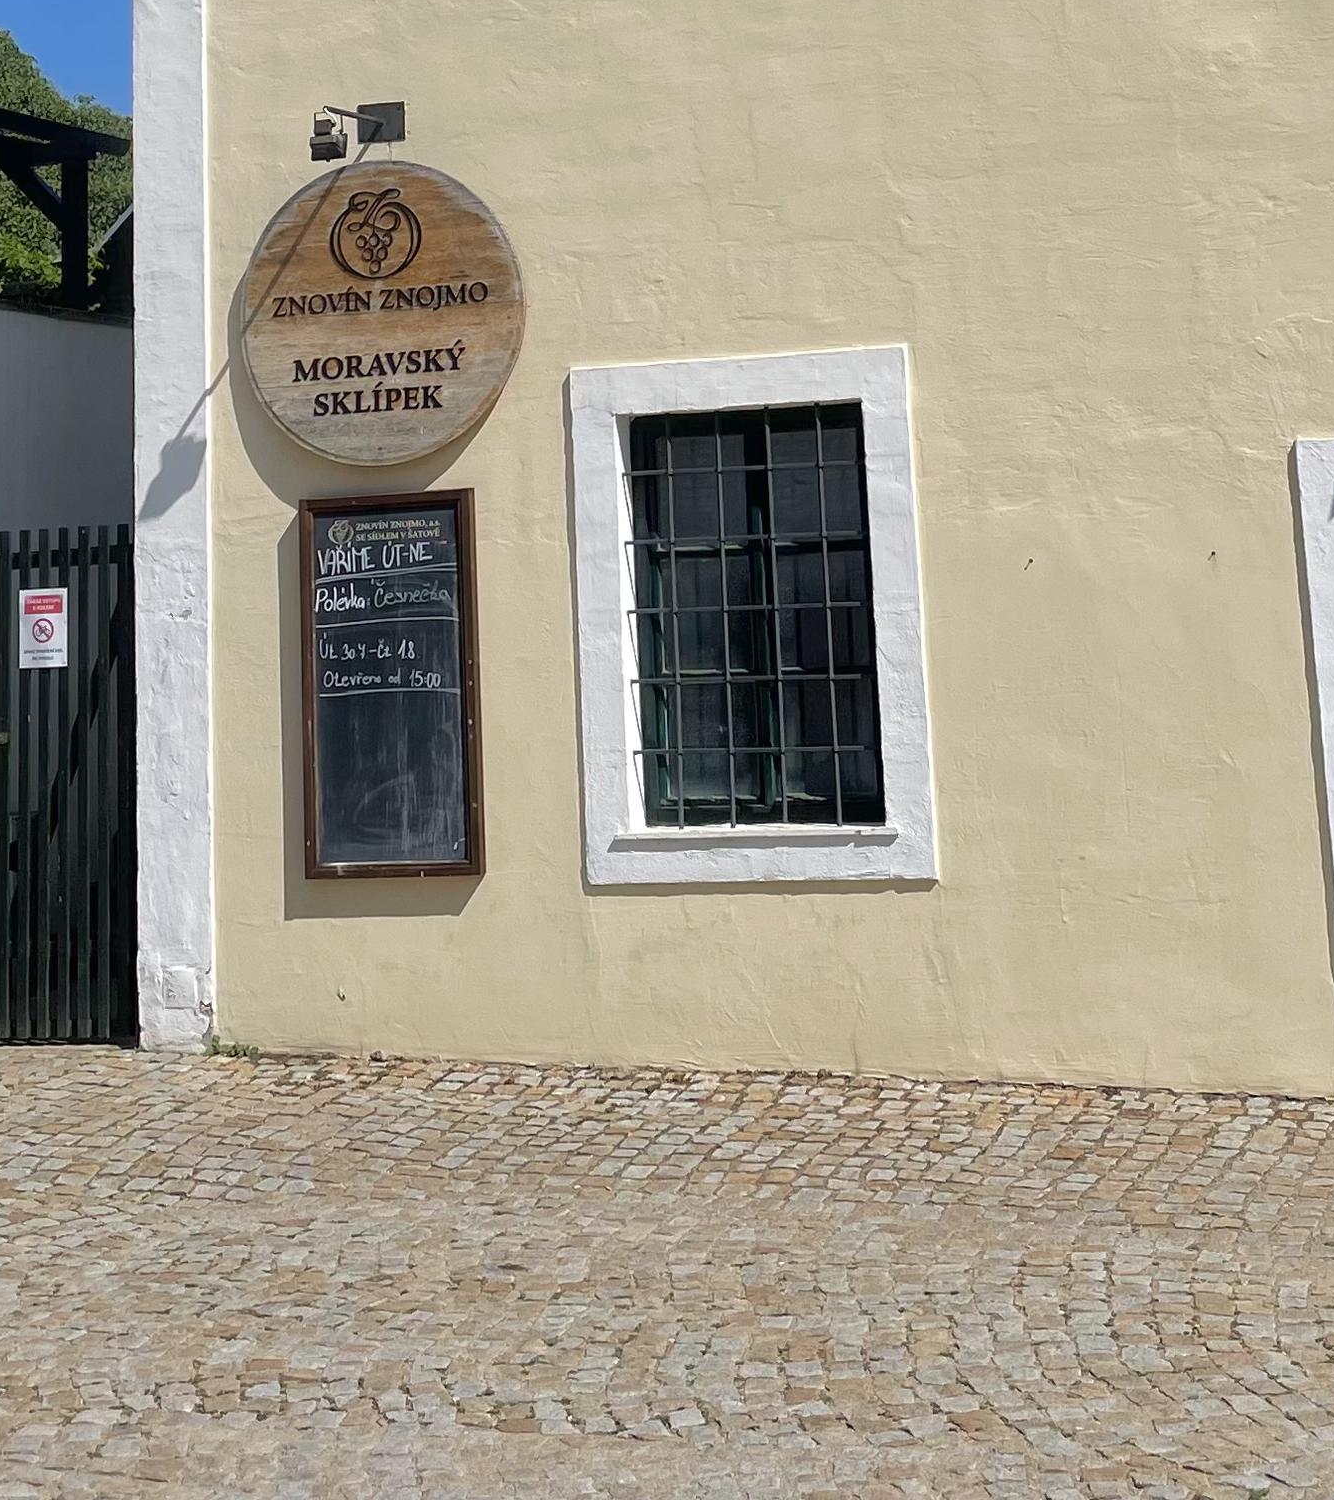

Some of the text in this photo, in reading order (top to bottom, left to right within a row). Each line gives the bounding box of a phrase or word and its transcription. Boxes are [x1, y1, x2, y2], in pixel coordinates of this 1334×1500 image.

[272, 281, 489, 318] ZNOVÍN ZNOJMO
[292, 340, 466, 383] MORAVSKÝ
[313, 382, 443, 417] SKLÍPEK
[356, 520, 388, 531] ZNOVÍN
[317, 542, 375, 575] VAŘÍME
[387, 667, 401, 685] od
[409, 669, 442, 688] 15:00
